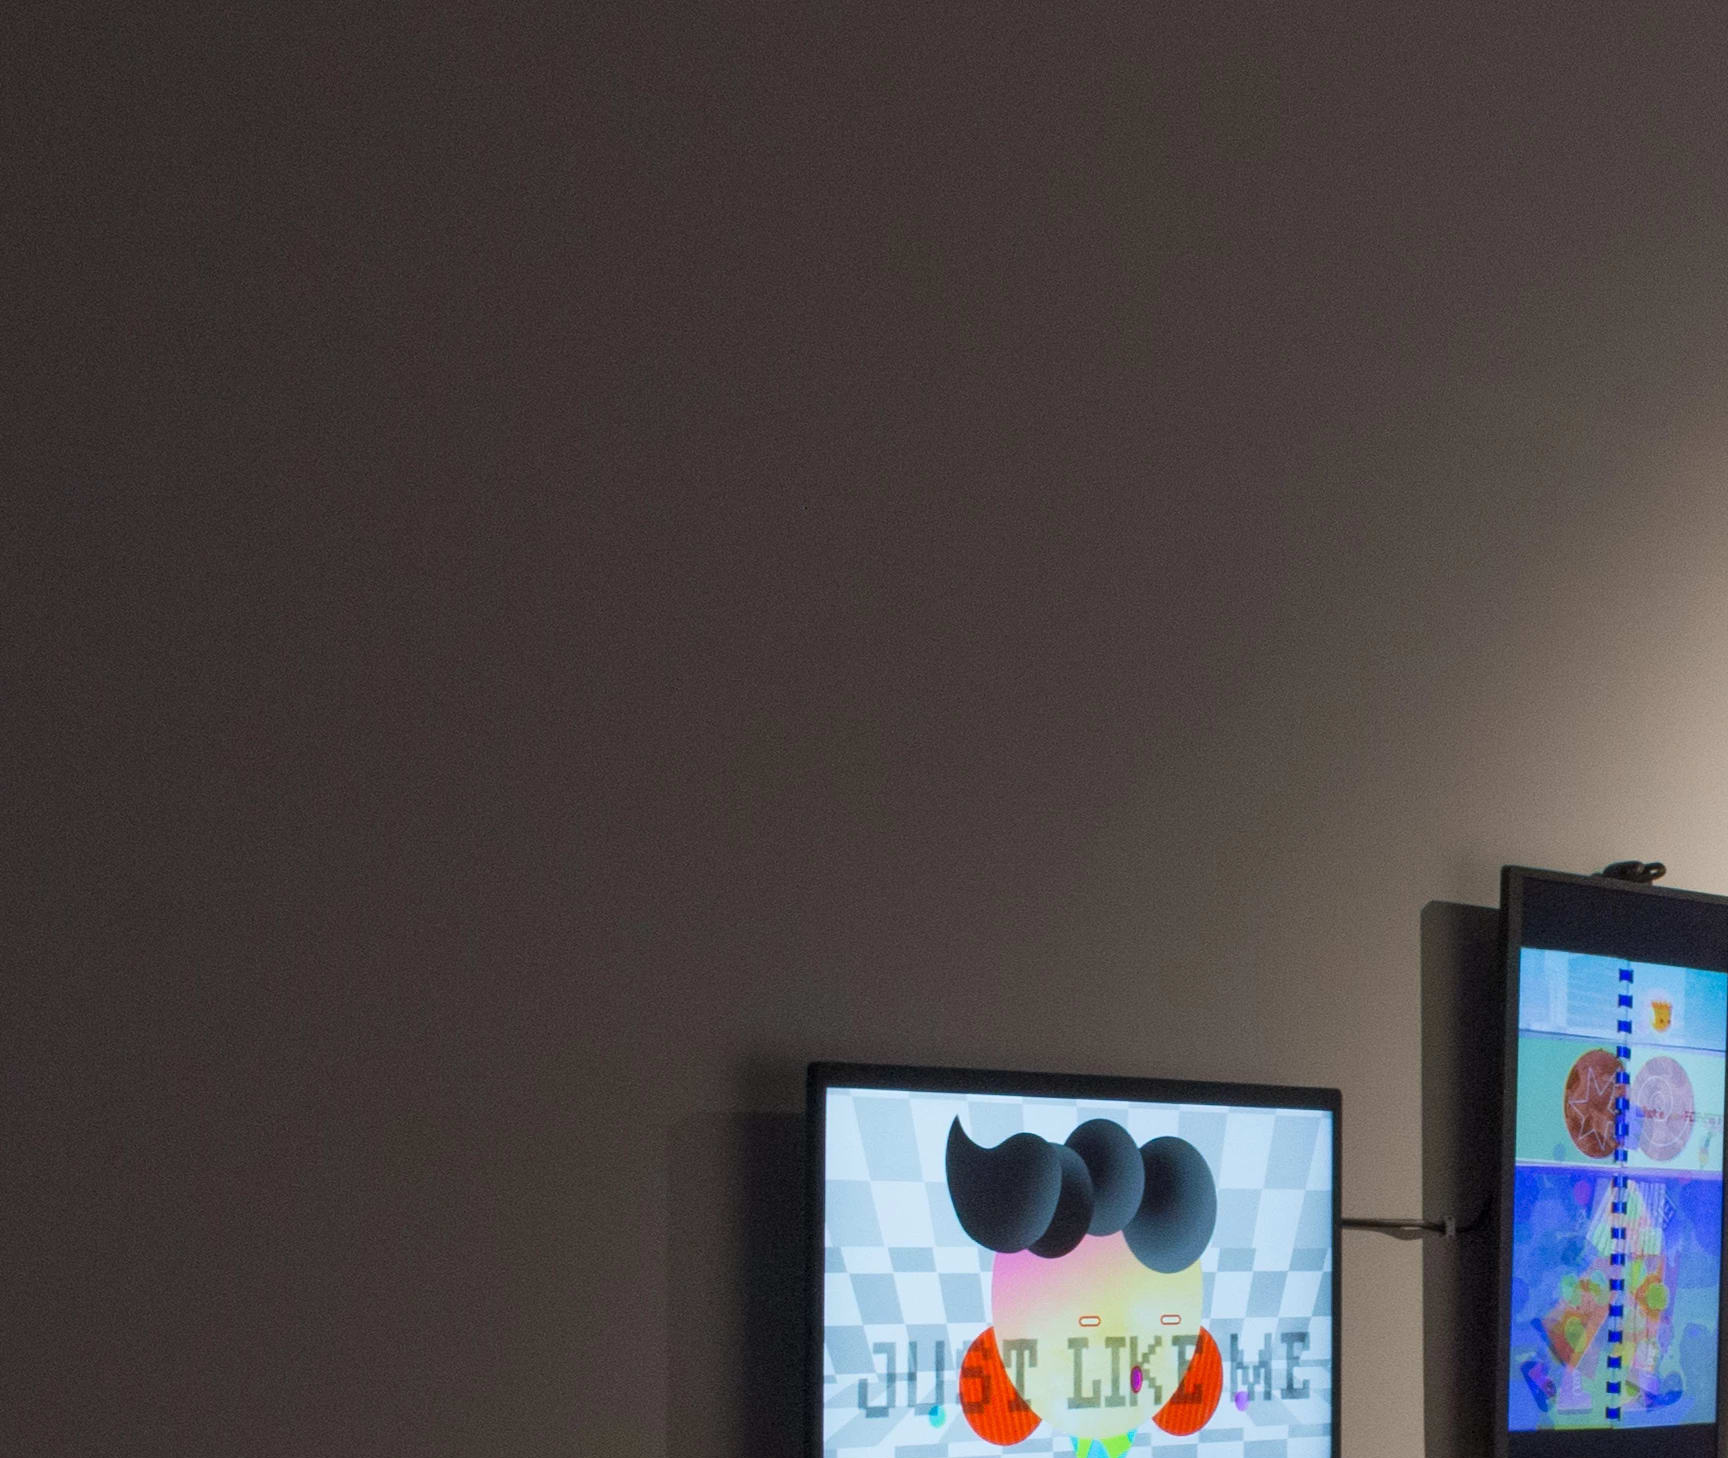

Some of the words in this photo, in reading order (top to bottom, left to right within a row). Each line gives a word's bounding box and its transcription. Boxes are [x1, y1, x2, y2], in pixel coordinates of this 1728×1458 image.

[857, 1338, 1039, 1418] JUST
[1067, 1334, 1203, 1410] LIKE
[1229, 1331, 1311, 1402] ME
